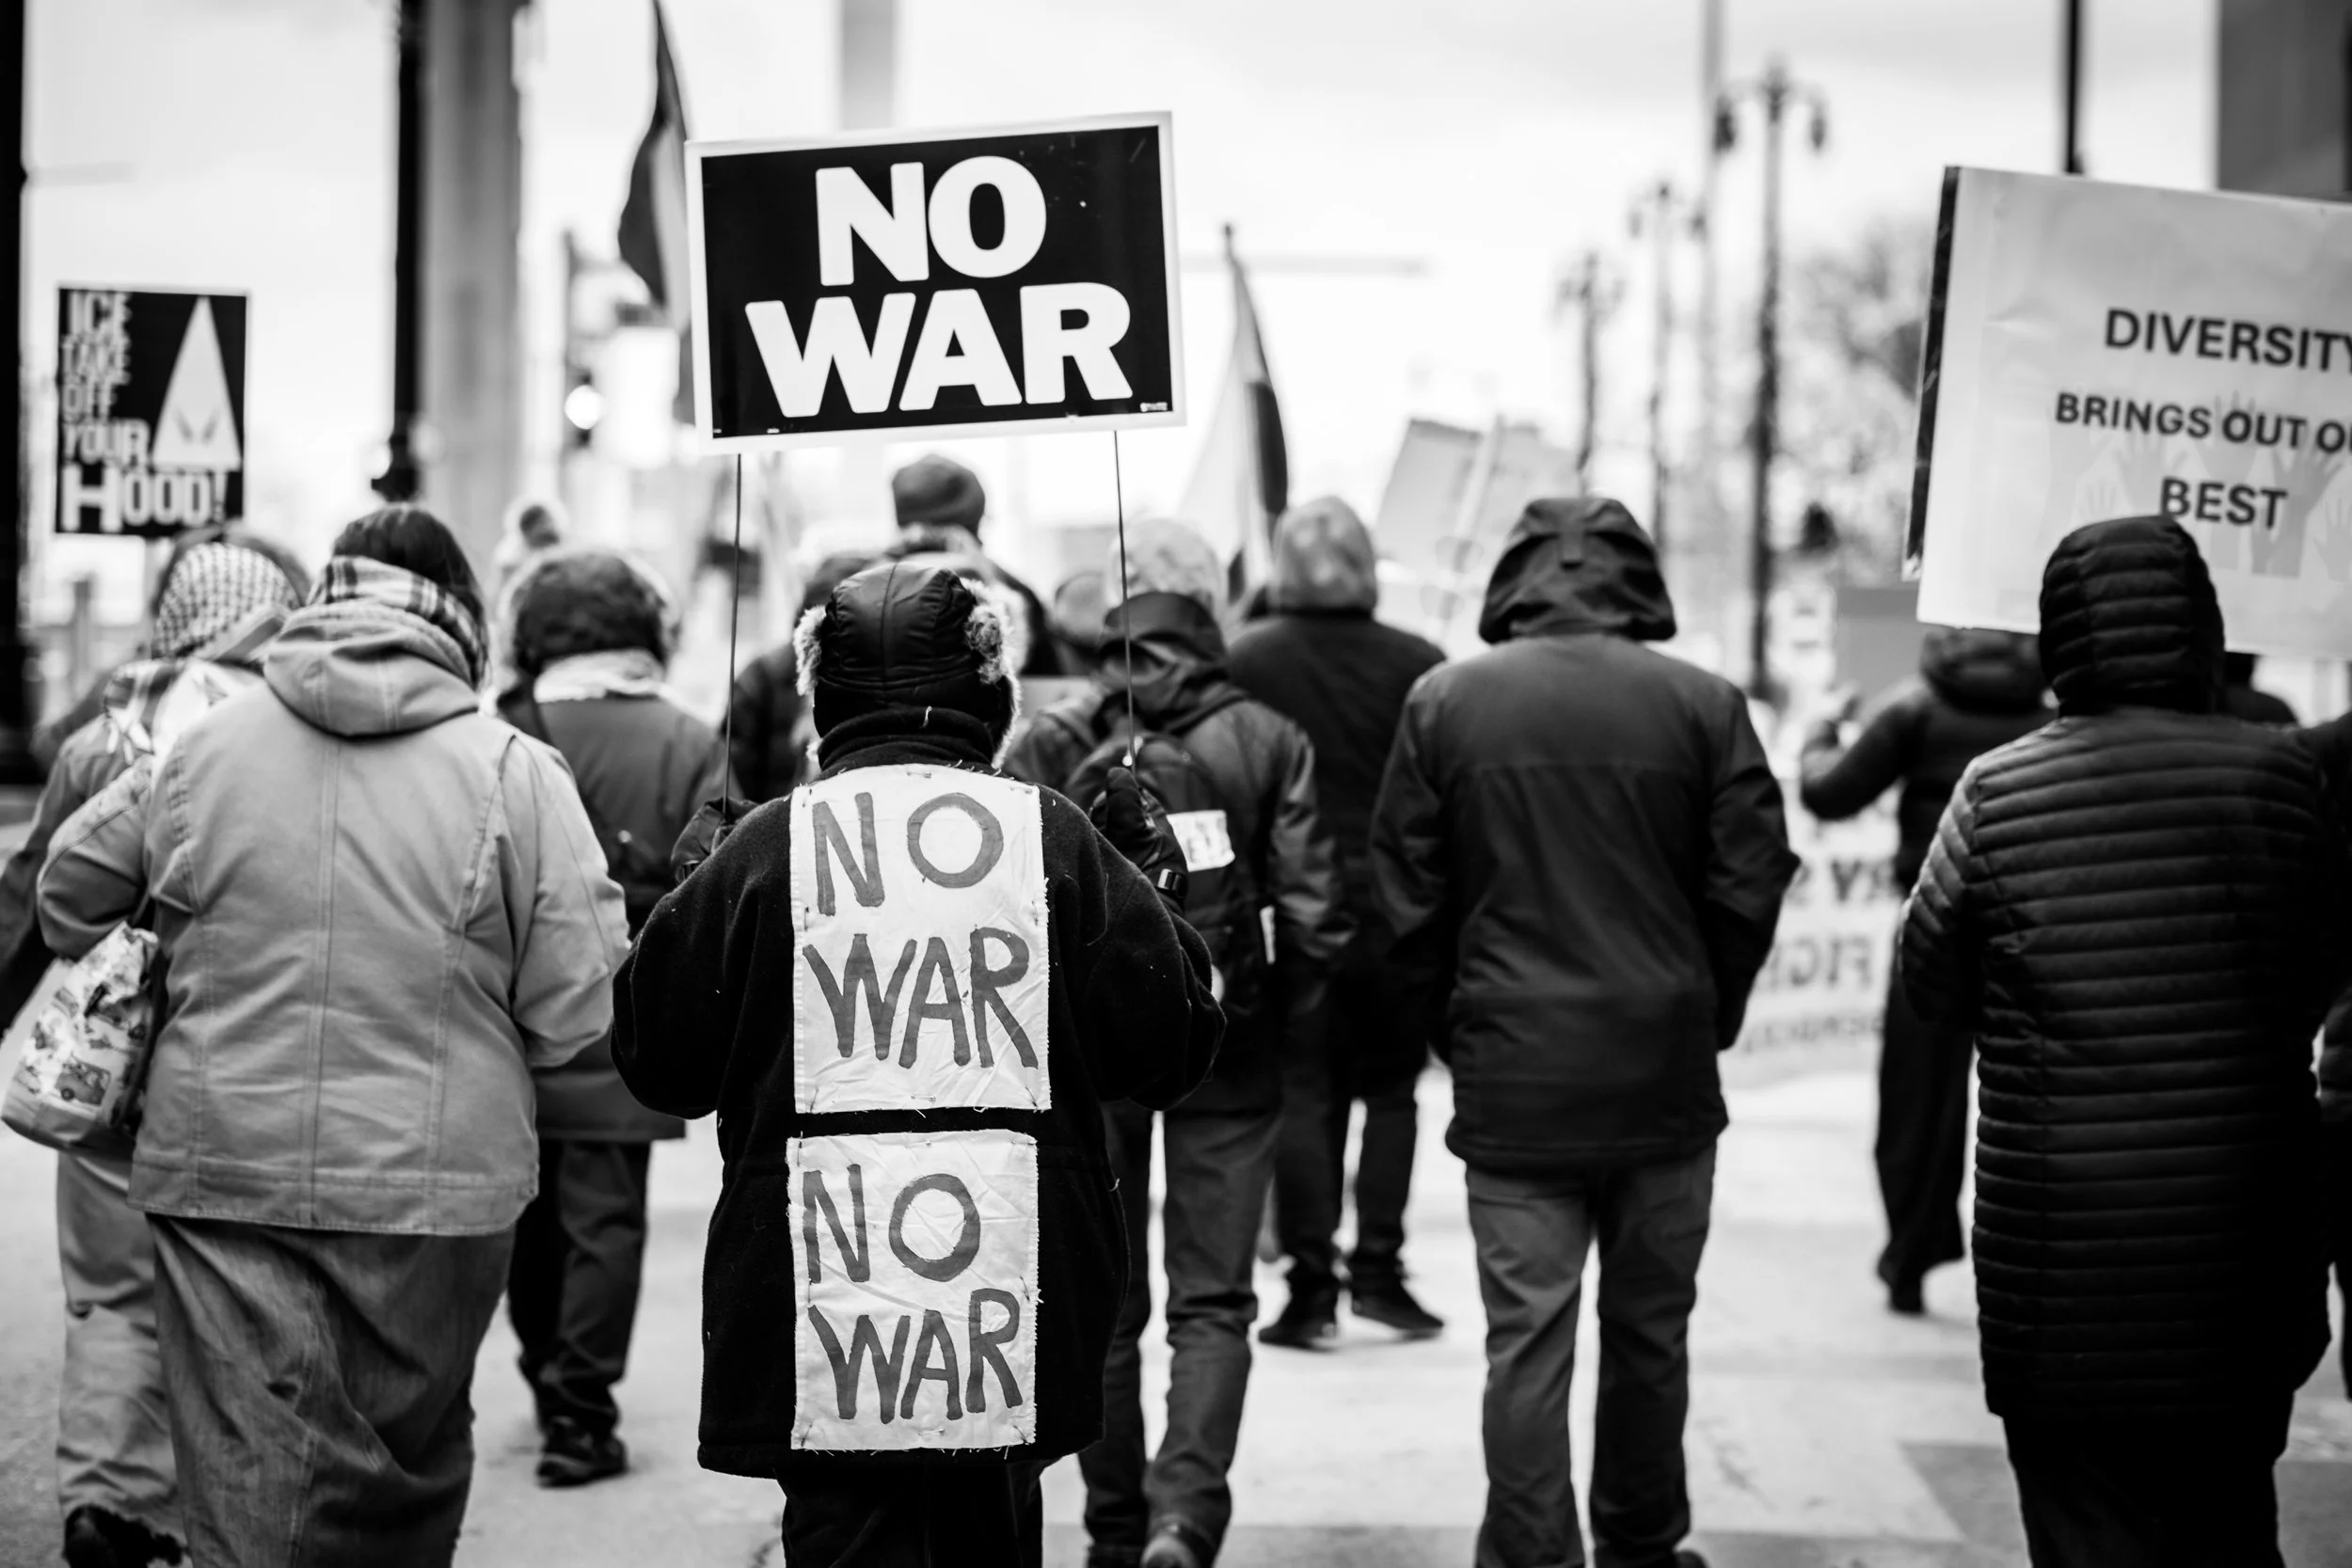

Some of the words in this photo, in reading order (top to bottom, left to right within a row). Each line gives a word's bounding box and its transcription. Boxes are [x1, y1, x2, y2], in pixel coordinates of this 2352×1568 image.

[816, 155, 1046, 286] NO
[67, 290, 131, 335] ICE
[744, 282, 1133, 418] WAR
[62, 418, 150, 468] YOUR
[2055, 391, 2212, 441] BRINGS
[2222, 409, 2308, 451] OUT
[2316, 419, 2352, 458] O
[2160, 475, 2288, 531] BEST
[812, 792, 1004, 916] NO
[803, 927, 1039, 1069] WAR
[803, 1164, 981, 1284] NO
[808, 1288, 1024, 1425] WAR
